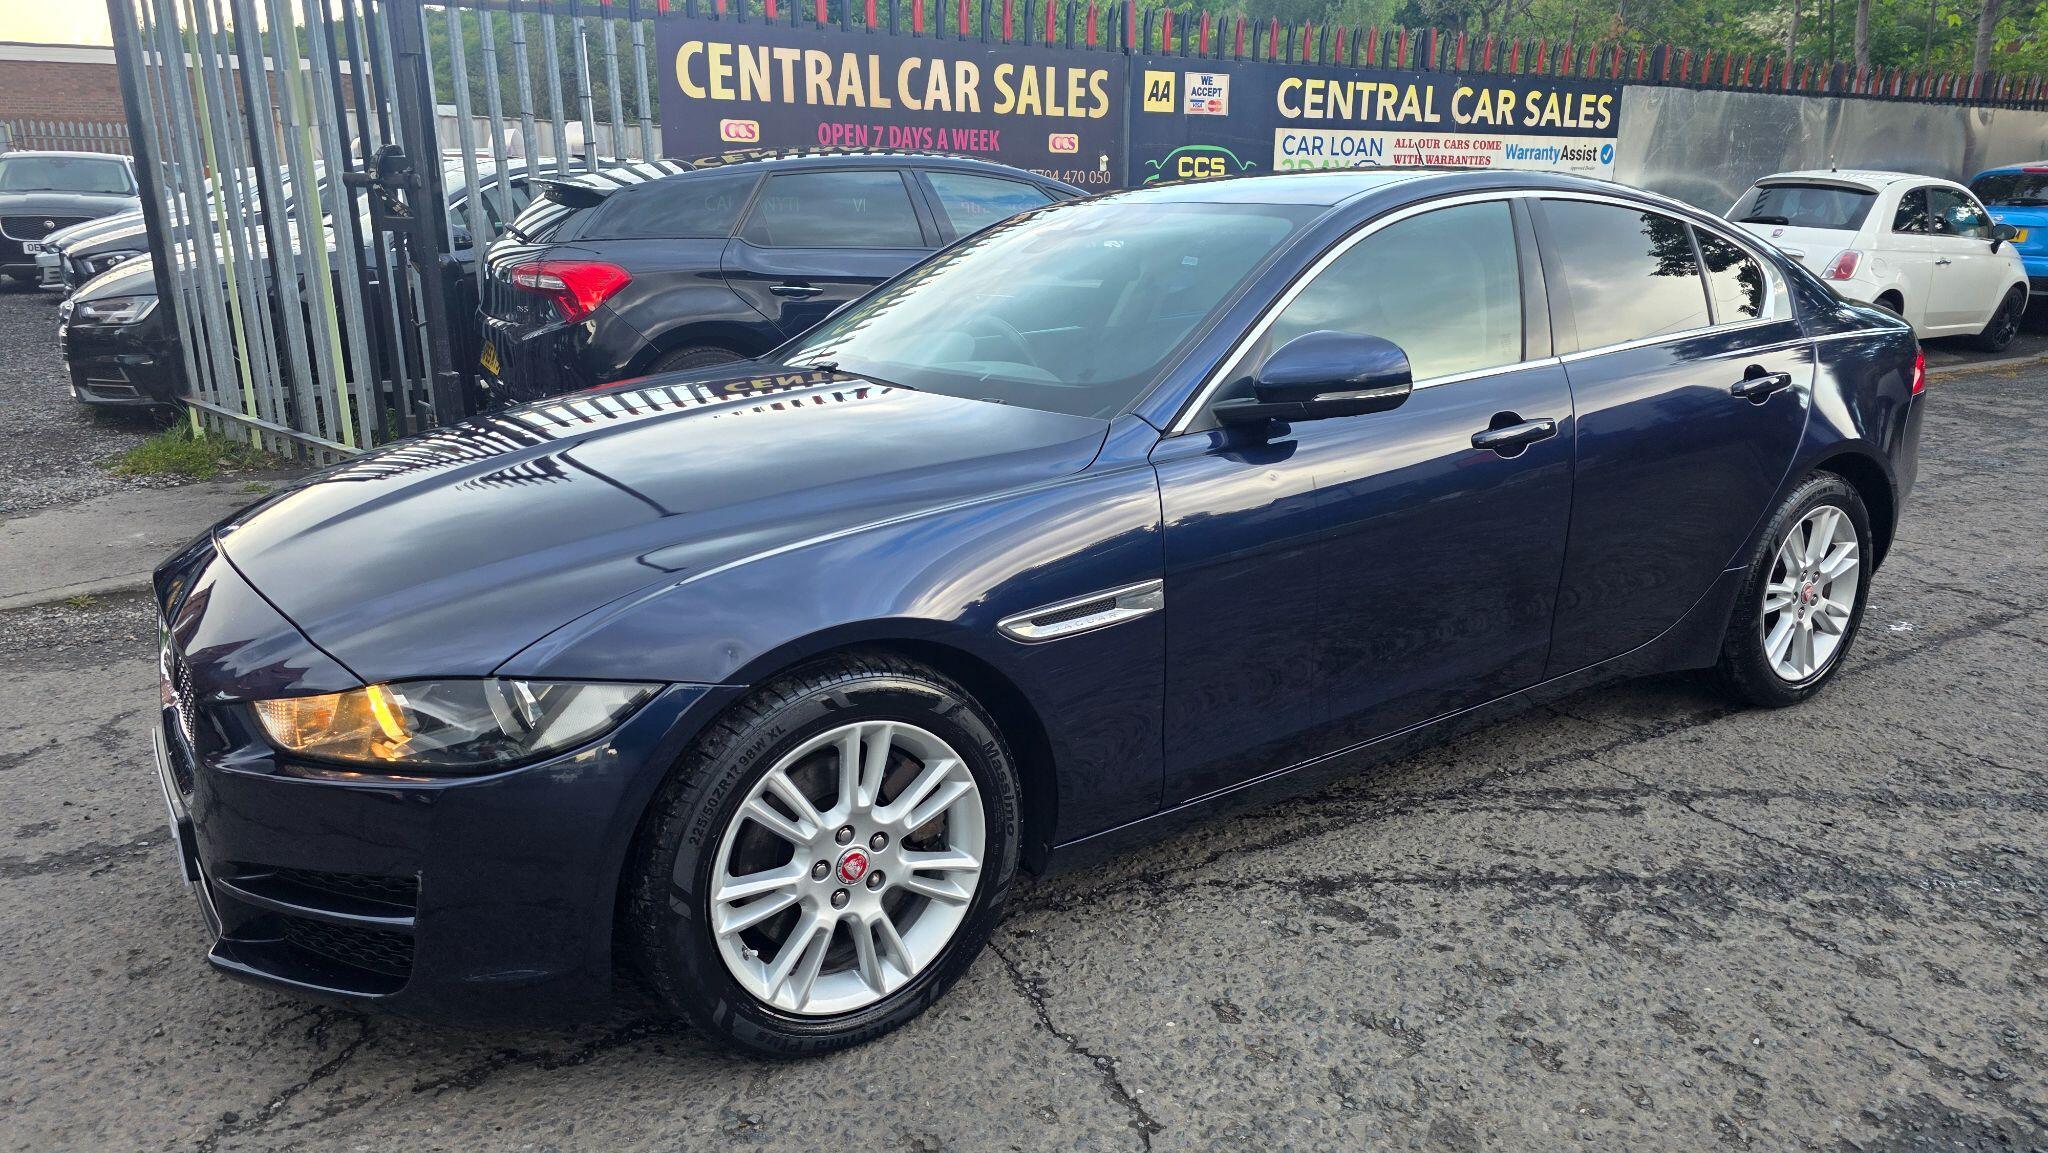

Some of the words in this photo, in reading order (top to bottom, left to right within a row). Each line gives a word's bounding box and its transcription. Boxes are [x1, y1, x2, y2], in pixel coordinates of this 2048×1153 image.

[676, 40, 892, 108] CENTRAL
[898, 57, 981, 113] CAR
[993, 63, 1109, 119] SALES
[1201, 76, 1213, 85] WE
[1148, 80, 1170, 102] AA
[1191, 88, 1222, 97] ACCEPT
[1277, 77, 1441, 123] CENTRAL
[1451, 86, 1516, 126] CAR
[1523, 90, 1613, 130] SALES
[725, 122, 756, 139] CCS
[817, 122, 867, 147] OPEN
[873, 126, 884, 148] 7
[889, 126, 933, 150] DAYS
[936, 129, 949, 150] A
[952, 128, 1000, 151] WEEK
[1051, 136, 1077, 151] CCS
[1282, 134, 1324, 156] CAR
[1331, 136, 1383, 157] LOAN
[1394, 138, 1416, 149] ALL
[1418, 138, 1440, 149] OUR
[1443, 139, 1470, 150] CARS
[1472, 140, 1502, 151] COME
[1178, 156, 1226, 177] CCS
[1393, 154, 1423, 165] WITH
[1425, 155, 1492, 166] WARRANTIES
[1063, 170, 1086, 184] 470
[1089, 170, 1111, 184] 050
[767, 725, 787, 743] XL
[982, 740, 1016, 837] Massimo
